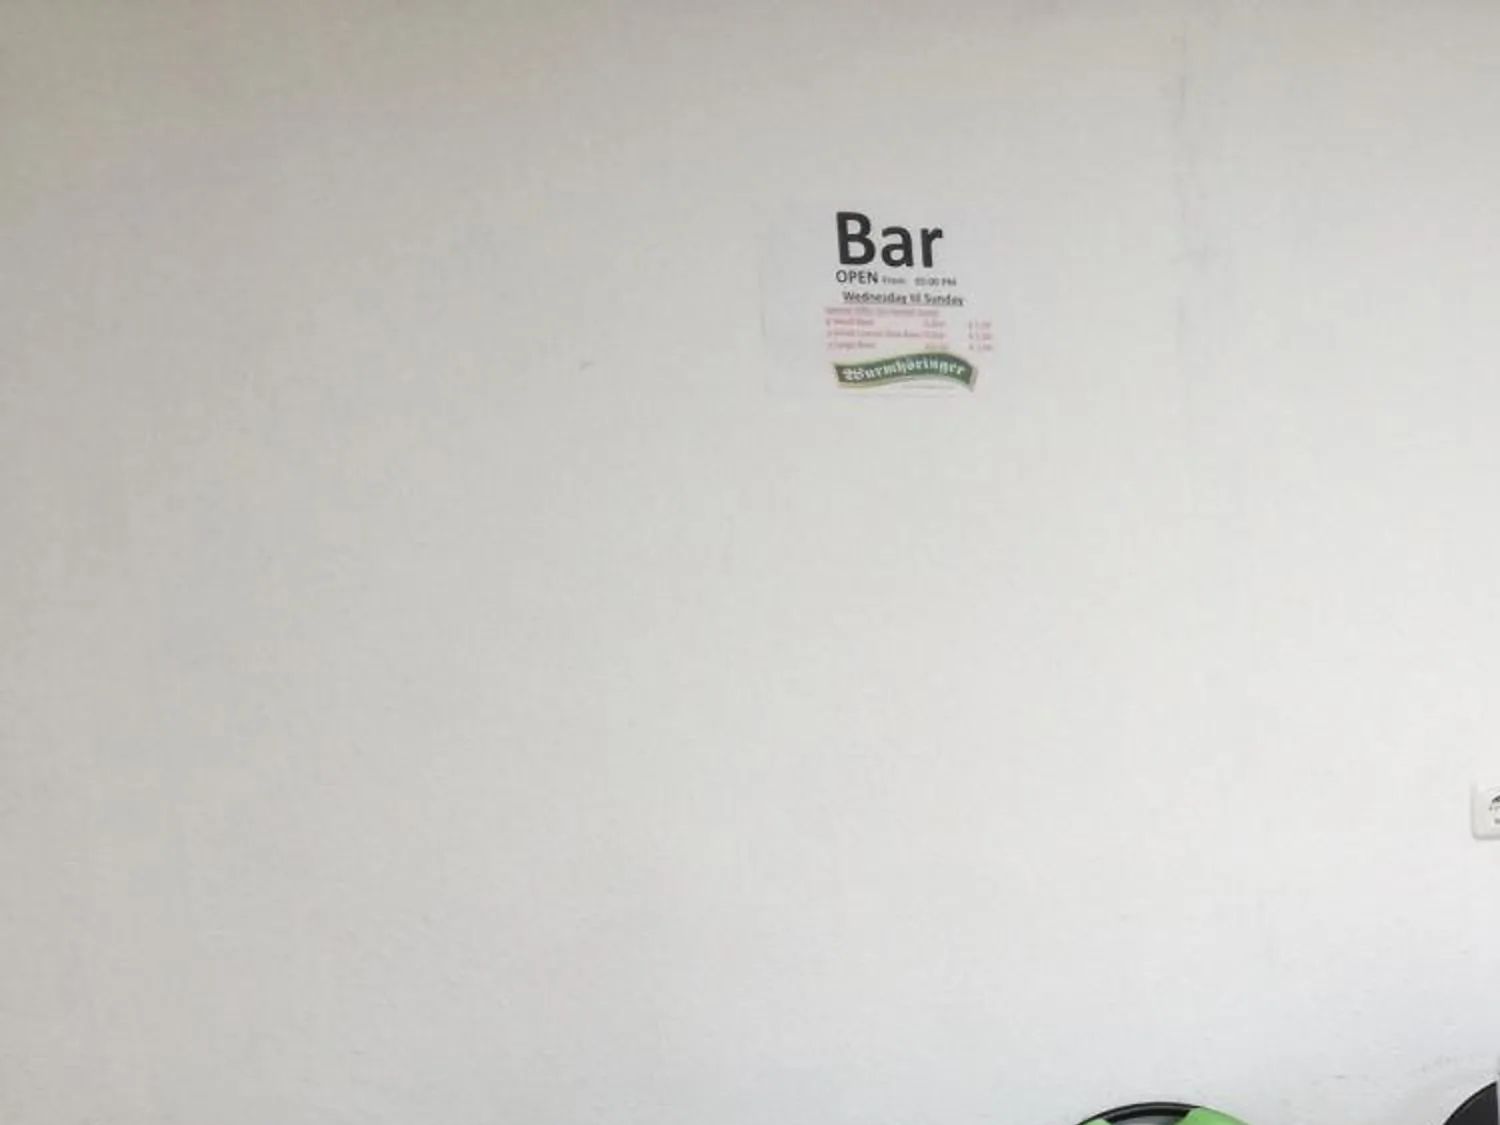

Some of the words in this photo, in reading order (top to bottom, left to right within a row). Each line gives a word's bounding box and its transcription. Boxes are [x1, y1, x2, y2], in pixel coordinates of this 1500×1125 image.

[836, 211, 943, 268] Bar
[835, 269, 879, 284] OPEN
[842, 291, 907, 305] Wednesday
[923, 293, 964, 306] Sunday
